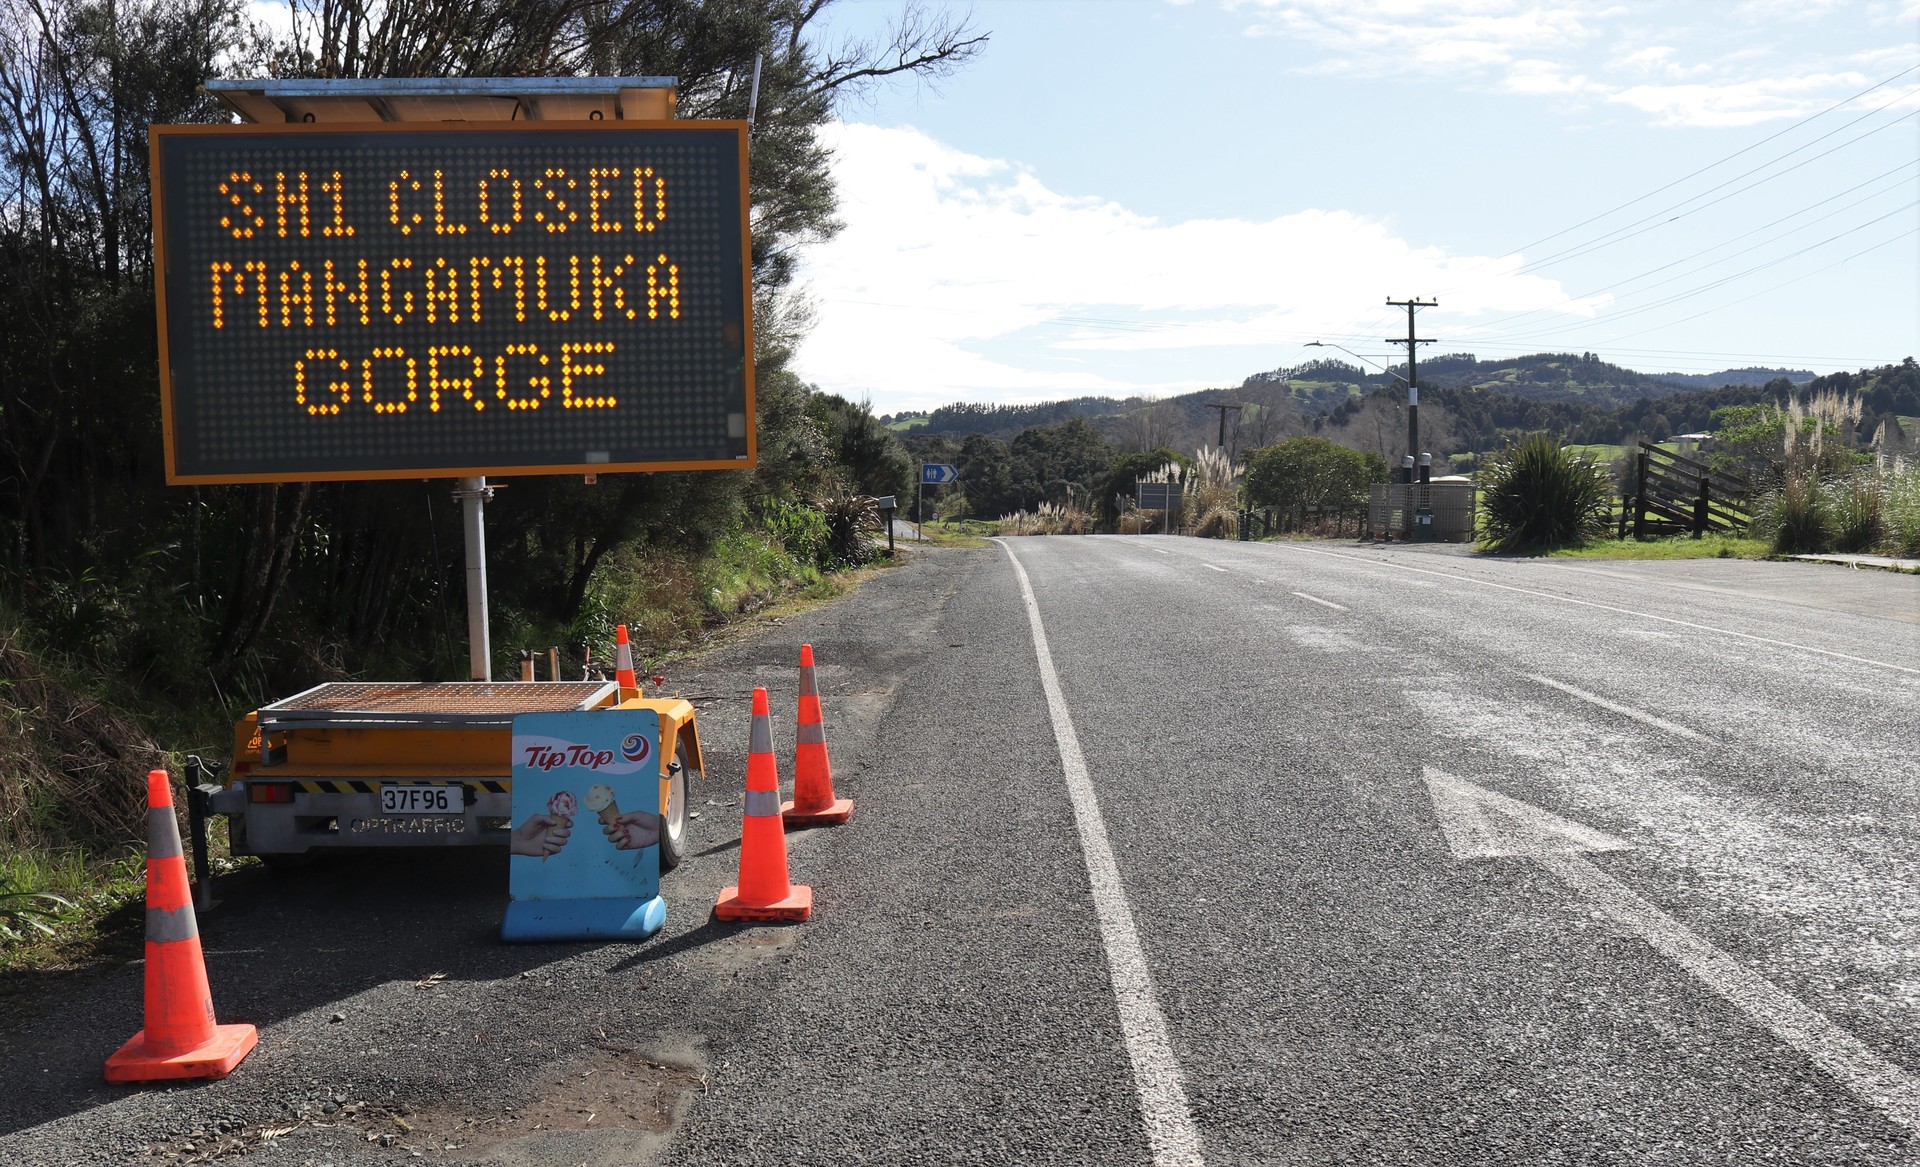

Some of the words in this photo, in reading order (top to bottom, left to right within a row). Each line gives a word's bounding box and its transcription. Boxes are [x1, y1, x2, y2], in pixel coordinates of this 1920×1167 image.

[220, 171, 355, 238] SH1
[389, 168, 666, 235] CLOSED
[211, 254, 679, 328] MANGAMUKA
[295, 342, 616, 415] GORGE
[525, 745, 566, 771] Tip
[567, 745, 614, 769] Top
[384, 790, 448, 810] 37F96
[351, 818, 465, 833] OPTRAFFIC
